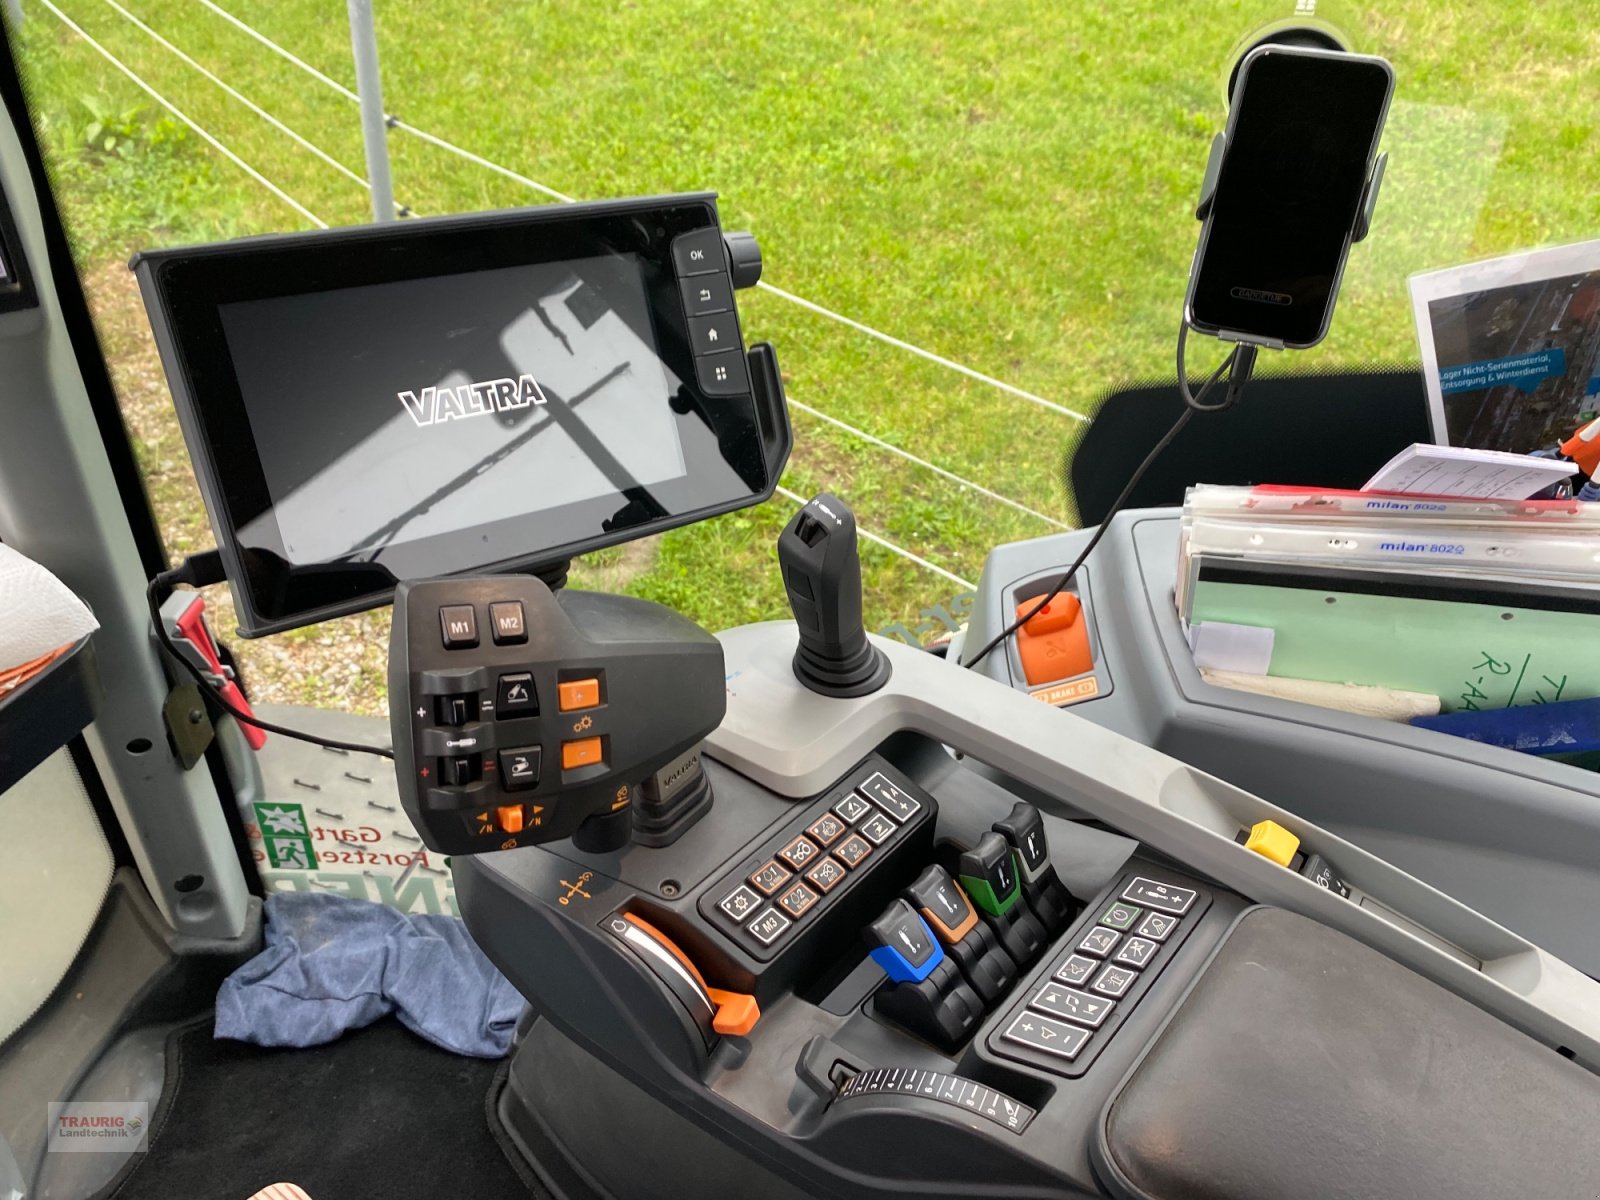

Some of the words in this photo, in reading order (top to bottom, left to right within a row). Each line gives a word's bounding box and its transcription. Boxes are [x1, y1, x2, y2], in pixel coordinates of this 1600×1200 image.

[690, 249, 704, 261] OK
[1463, 353, 1551, 376] Nicht-Serienmaterial,
[1440, 376, 1487, 390] Entsorgung
[1487, 373, 1495, 382] &
[1495, 364, 1549, 381] Winterdienst
[398, 374, 547, 427] VALTRA
[1366, 500, 1409, 511] milan
[1380, 542, 1425, 553] milan
[450, 621, 470, 634] M1
[499, 616, 520, 630] M2
[664, 755, 697, 786] VALTRA
[1156, 886, 1167, 894] B
[762, 917, 778, 933] M3
[966, 1099, 974, 1107] 8
[987, 1108, 996, 1116] 9
[1008, 1116, 1018, 1128] 10
